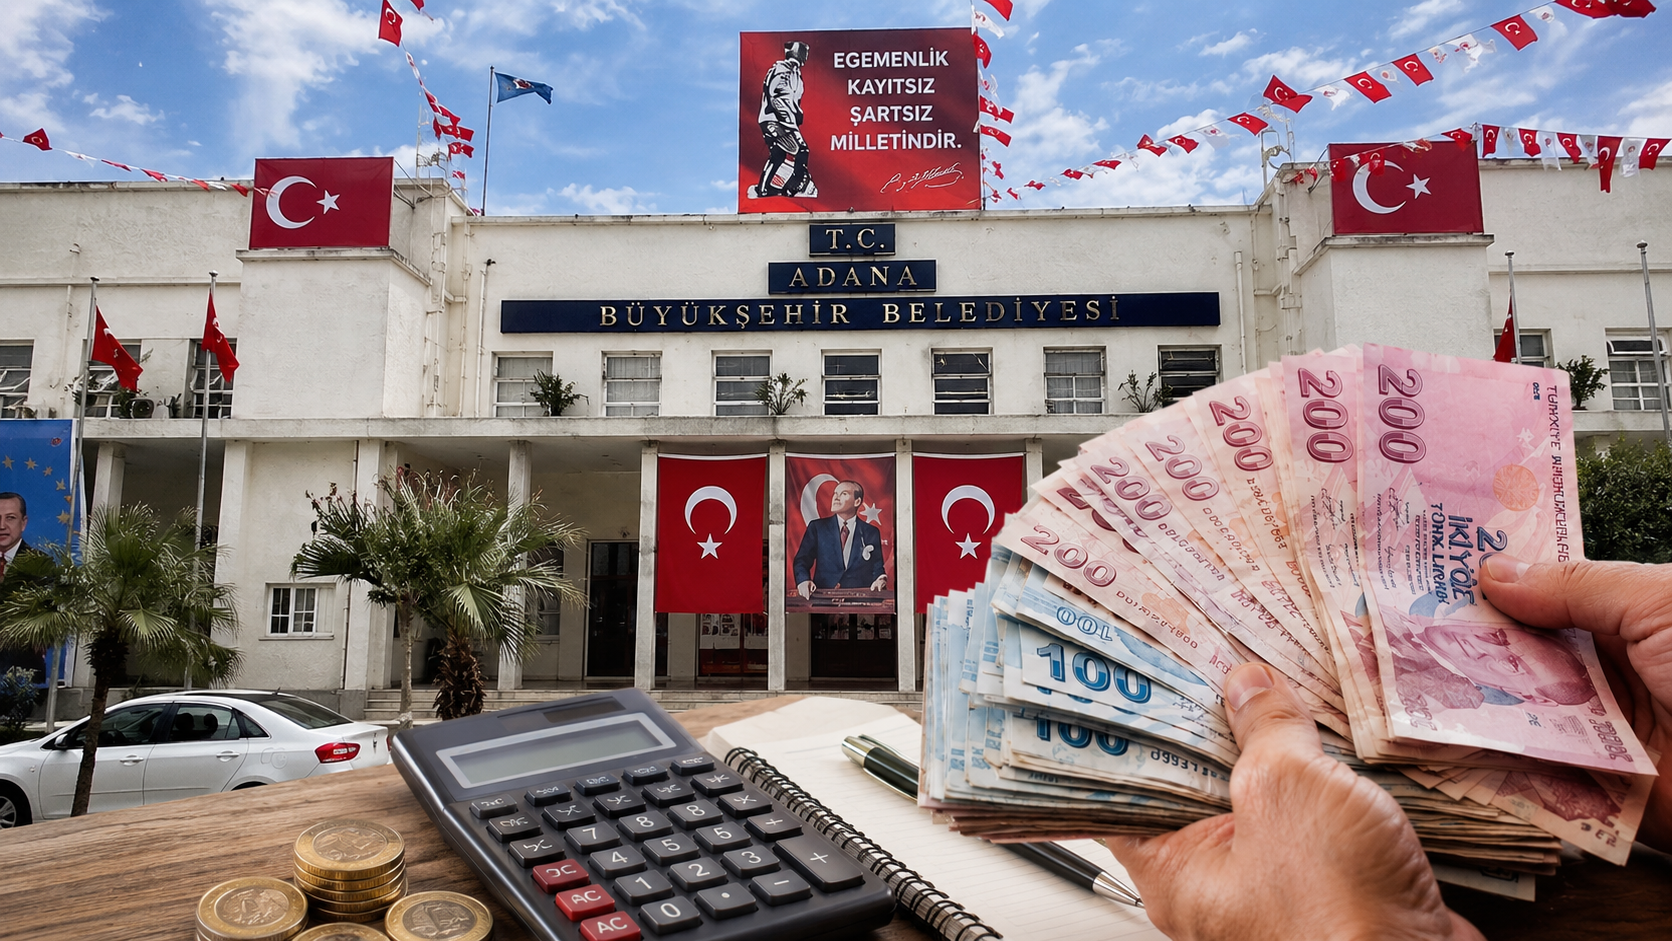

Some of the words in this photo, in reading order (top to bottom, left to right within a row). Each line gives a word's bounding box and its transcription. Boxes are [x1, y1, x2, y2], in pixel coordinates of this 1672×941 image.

[833, 47, 949, 69] EGEMENLİK
[848, 78, 935, 95] KAYITSIZ
[850, 105, 933, 127] ŞARTSIZ
[830, 129, 963, 151] MİLLETİNDİR.
[826, 228, 886, 250] T.C.
[788, 265, 919, 288] ADANA
[599, 298, 851, 330] BÜYÜKŞEHİR
[883, 294, 1121, 324] BELEDİYESİ
[1298, 367, 1354, 464] 200
[1378, 363, 1427, 464] 200
[1209, 396, 1274, 471] 200
[1145, 435, 1219, 502] 200
[1090, 456, 1174, 521] 200
[1021, 524, 1117, 588] 200
[1036, 642, 1152, 704] 100
[570, 889, 603, 905] AC
[596, 916, 628, 933] AC
